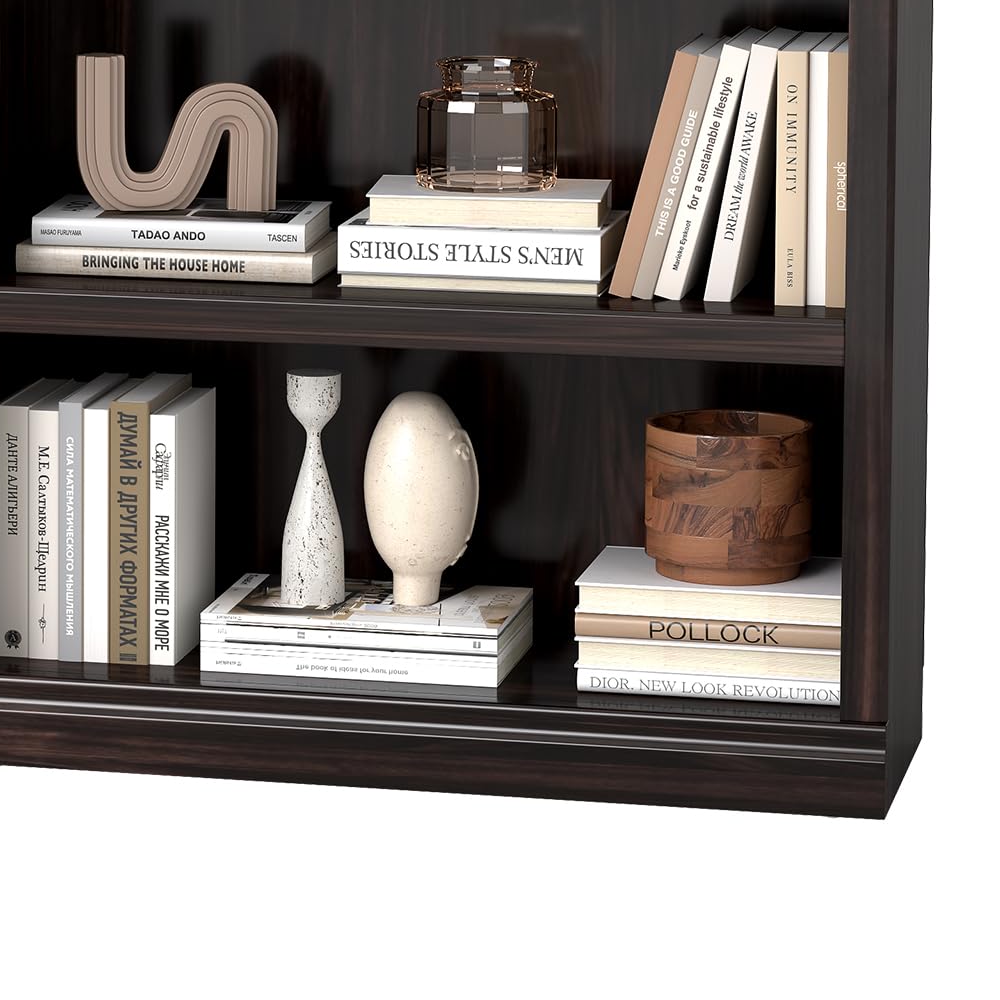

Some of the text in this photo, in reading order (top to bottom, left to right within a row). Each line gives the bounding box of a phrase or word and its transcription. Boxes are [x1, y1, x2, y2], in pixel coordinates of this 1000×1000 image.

[687, 194, 700, 210] for
[697, 121, 720, 183] sustainable
[712, 76, 734, 119] lifestyle
[785, 84, 798, 194] ON IMMUNITY
[655, 109, 698, 236] THIS IS A GOOD GUIDE
[723, 111, 758, 241] DREAM the world AWAKE
[833, 160, 847, 212] spherical
[40, 228, 82, 237] MASAO FURUYAMA
[82, 254, 245, 273] BRINGING THE HOUSE HOME
[131, 229, 206, 241] TADAO ANDO
[349, 240, 584, 267] MEN'S STYLE STORIES
[672, 220, 692, 271] Marieke Eyskoot
[117, 411, 143, 470] ДУМАЙ
[6, 433, 18, 537] ДАНТЕ АЛИГЬЕРИ
[120, 477, 137, 486] В
[35, 445, 50, 593] М.Е. Салтыков-Щедрин
[65, 436, 75, 636] СИЛА МАТЕМАТИЧЕСКОГО МЫШЛЕНИЯ
[117, 490, 138, 555] ДРУГИХ
[118, 560, 138, 648] ФОРМАТАХ
[154, 514, 170, 652] РАССКАЖИ МНЕ О МОРЕ
[649, 621, 779, 645] POLLOCK
[590, 676, 840, 701] DIOR. NEW LOOK REVOLUTION
